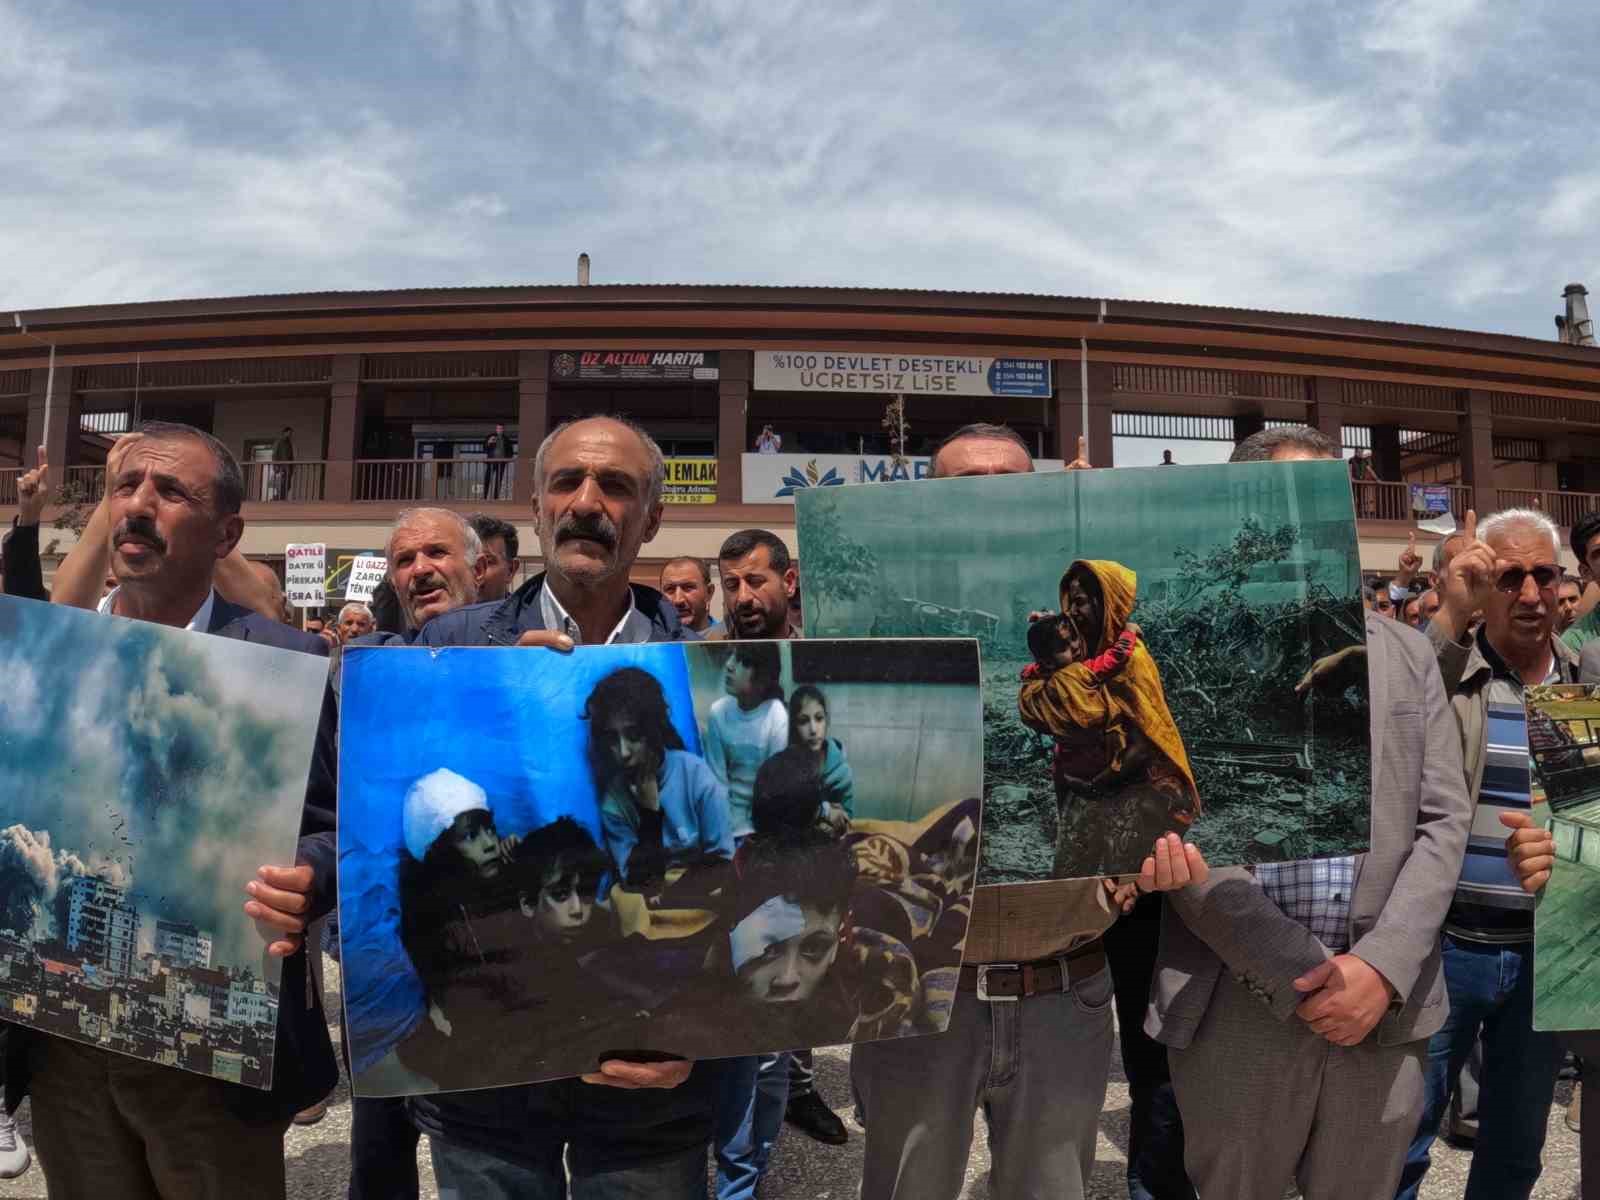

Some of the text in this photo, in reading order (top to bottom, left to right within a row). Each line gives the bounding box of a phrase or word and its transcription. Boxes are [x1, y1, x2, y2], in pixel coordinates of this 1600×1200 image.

[604, 352, 649, 365] ALTUN
[651, 351, 705, 365] HARİTA
[772, 354, 817, 369] %100
[824, 356, 892, 371] DEVLET
[675, 463, 717, 481] EMLAK
[366, 560, 386, 569] GAZZ
[355, 571, 382, 582] ZARO
